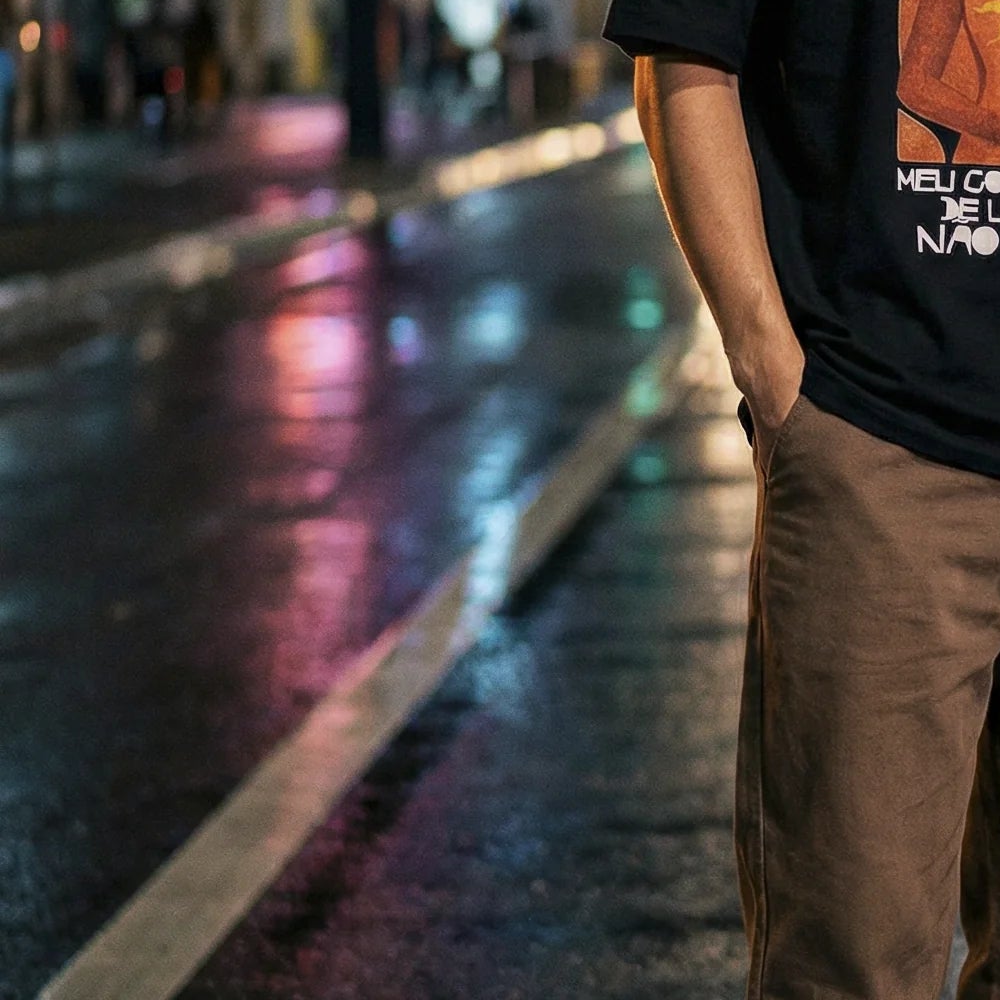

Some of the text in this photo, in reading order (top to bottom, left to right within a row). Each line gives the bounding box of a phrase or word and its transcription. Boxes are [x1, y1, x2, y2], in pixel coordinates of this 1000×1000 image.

[896, 166, 956, 193] MEU
[940, 195, 980, 224] DE
[916, 218, 1000, 256] NÃO
